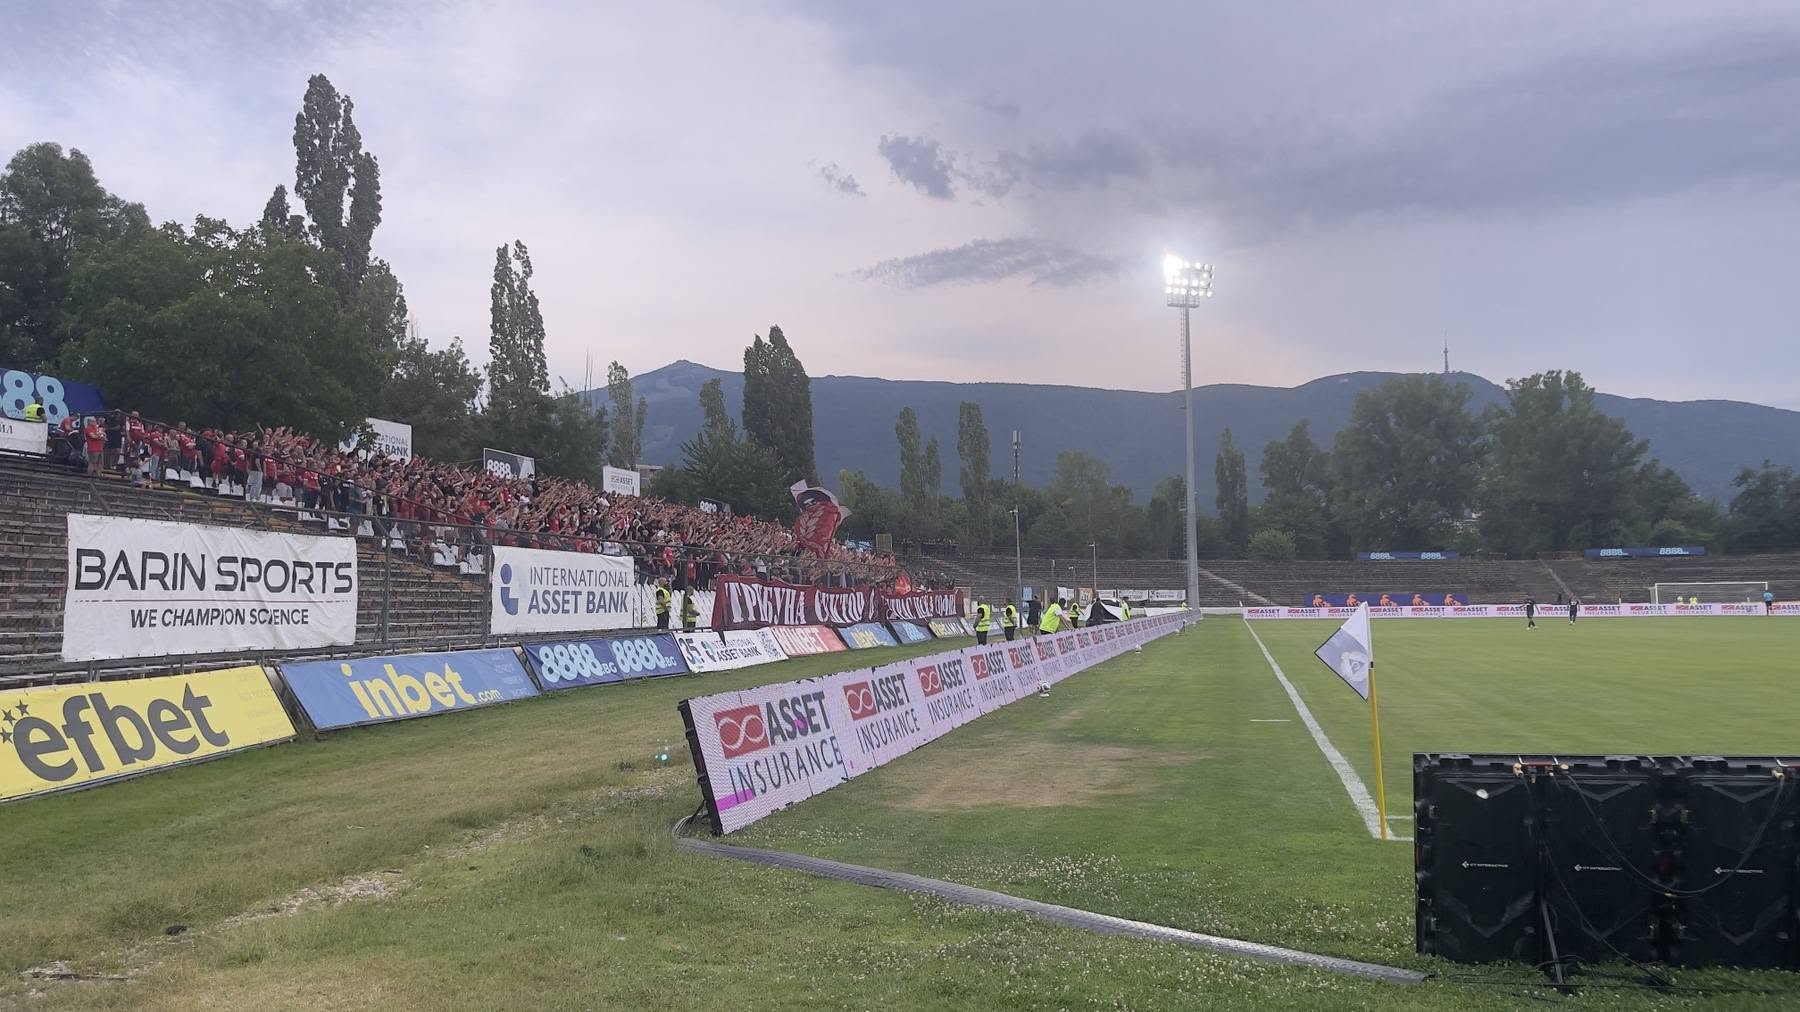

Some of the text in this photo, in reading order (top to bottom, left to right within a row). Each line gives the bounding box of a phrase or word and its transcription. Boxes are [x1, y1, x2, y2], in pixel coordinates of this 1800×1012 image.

[0, 370, 69, 424] 88
[385, 444, 408, 457] BANK
[75, 548, 353, 594] BARIN SPORTS
[530, 566, 629, 588] INTERNATIONAL
[130, 608, 309, 628] WE CHAMPION SCIENCE
[527, 589, 629, 615] ASSET BANK
[539, 643, 617, 683] 8888.BG
[612, 638, 677, 673] 8888.BG
[716, 646, 762, 662] ASSET BANK
[985, 650, 1008, 675] ASSET
[870, 673, 911, 713] ASSET
[936, 659, 967, 691] ASSET
[979, 675, 1014, 702] INSURANCE
[765, 690, 832, 746] ASSET
[927, 687, 975, 725] INSURANCE
[13, 682, 230, 782] efbet
[856, 708, 921, 755] INSURANCE
[728, 736, 844, 804] INSURANCE
